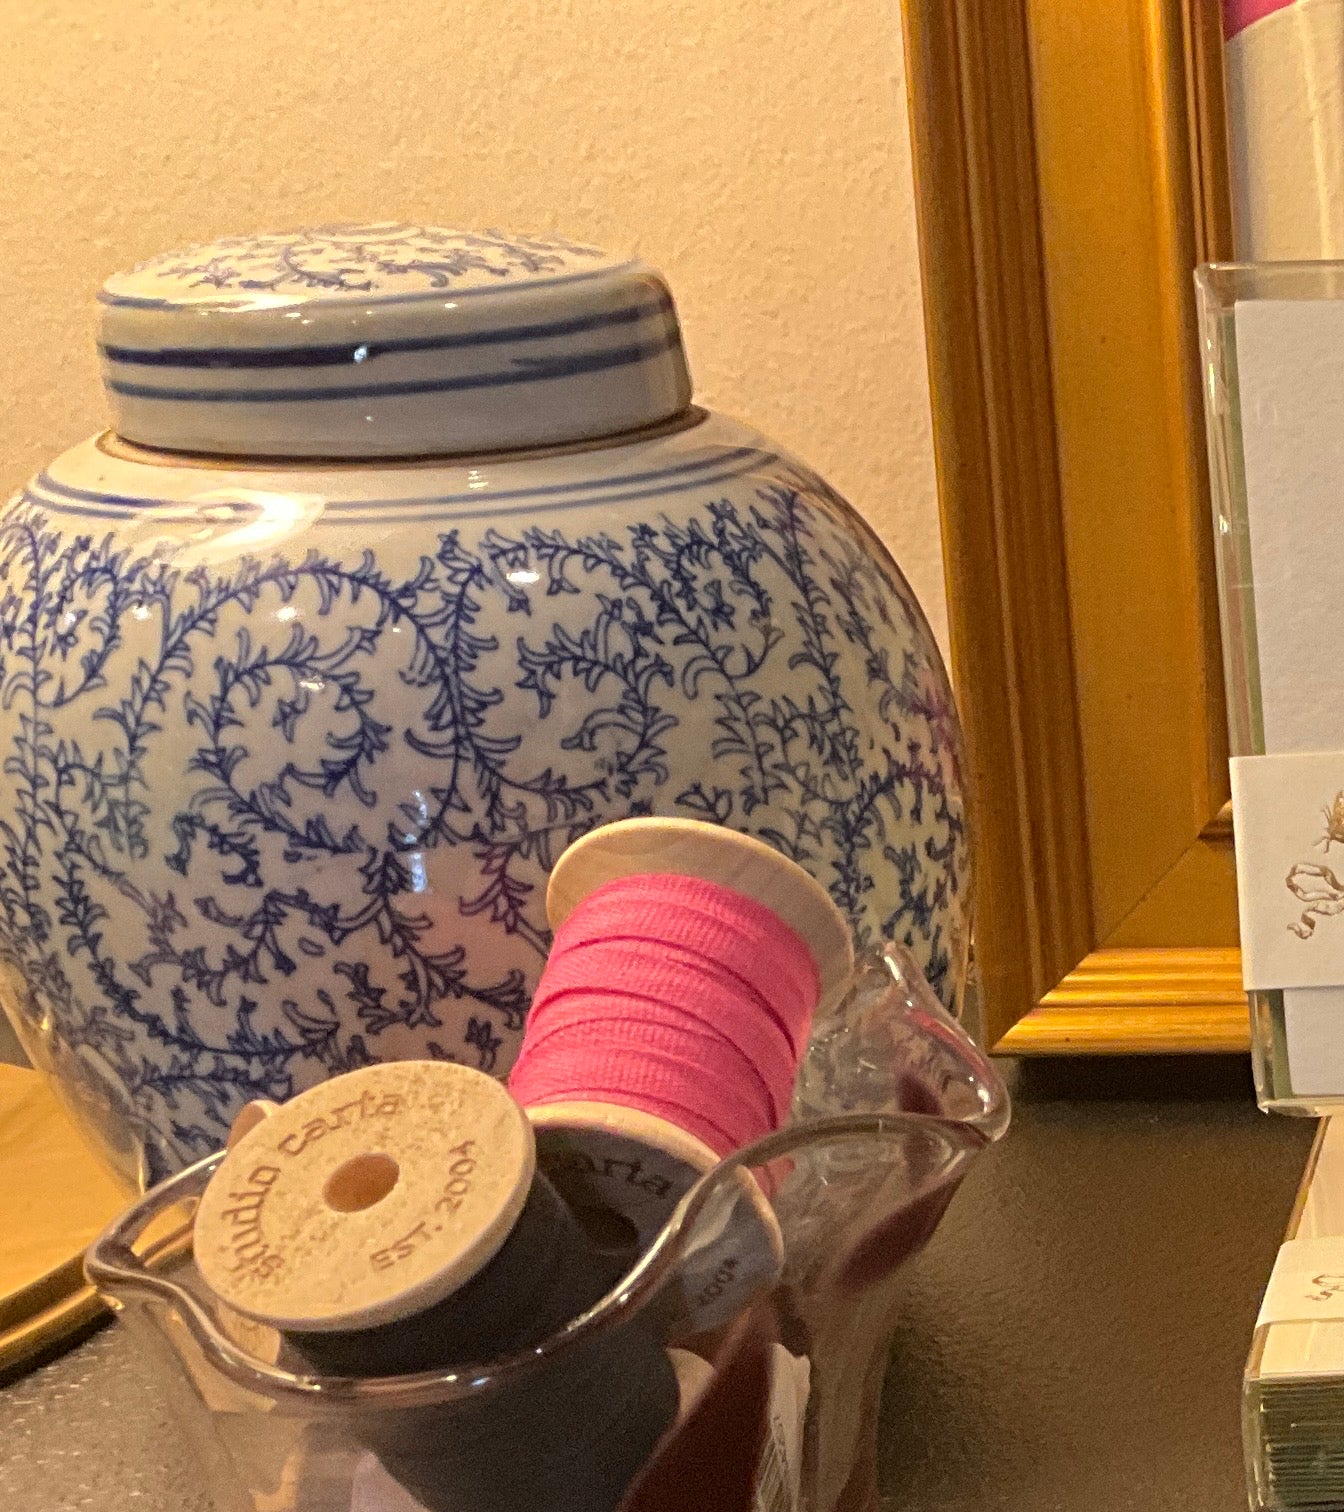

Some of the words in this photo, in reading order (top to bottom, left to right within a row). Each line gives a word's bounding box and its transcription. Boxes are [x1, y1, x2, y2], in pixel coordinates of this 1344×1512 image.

[278, 1089, 404, 1157] carta
[371, 1221, 444, 1273] EST.
[436, 1140, 477, 1214] 2004
